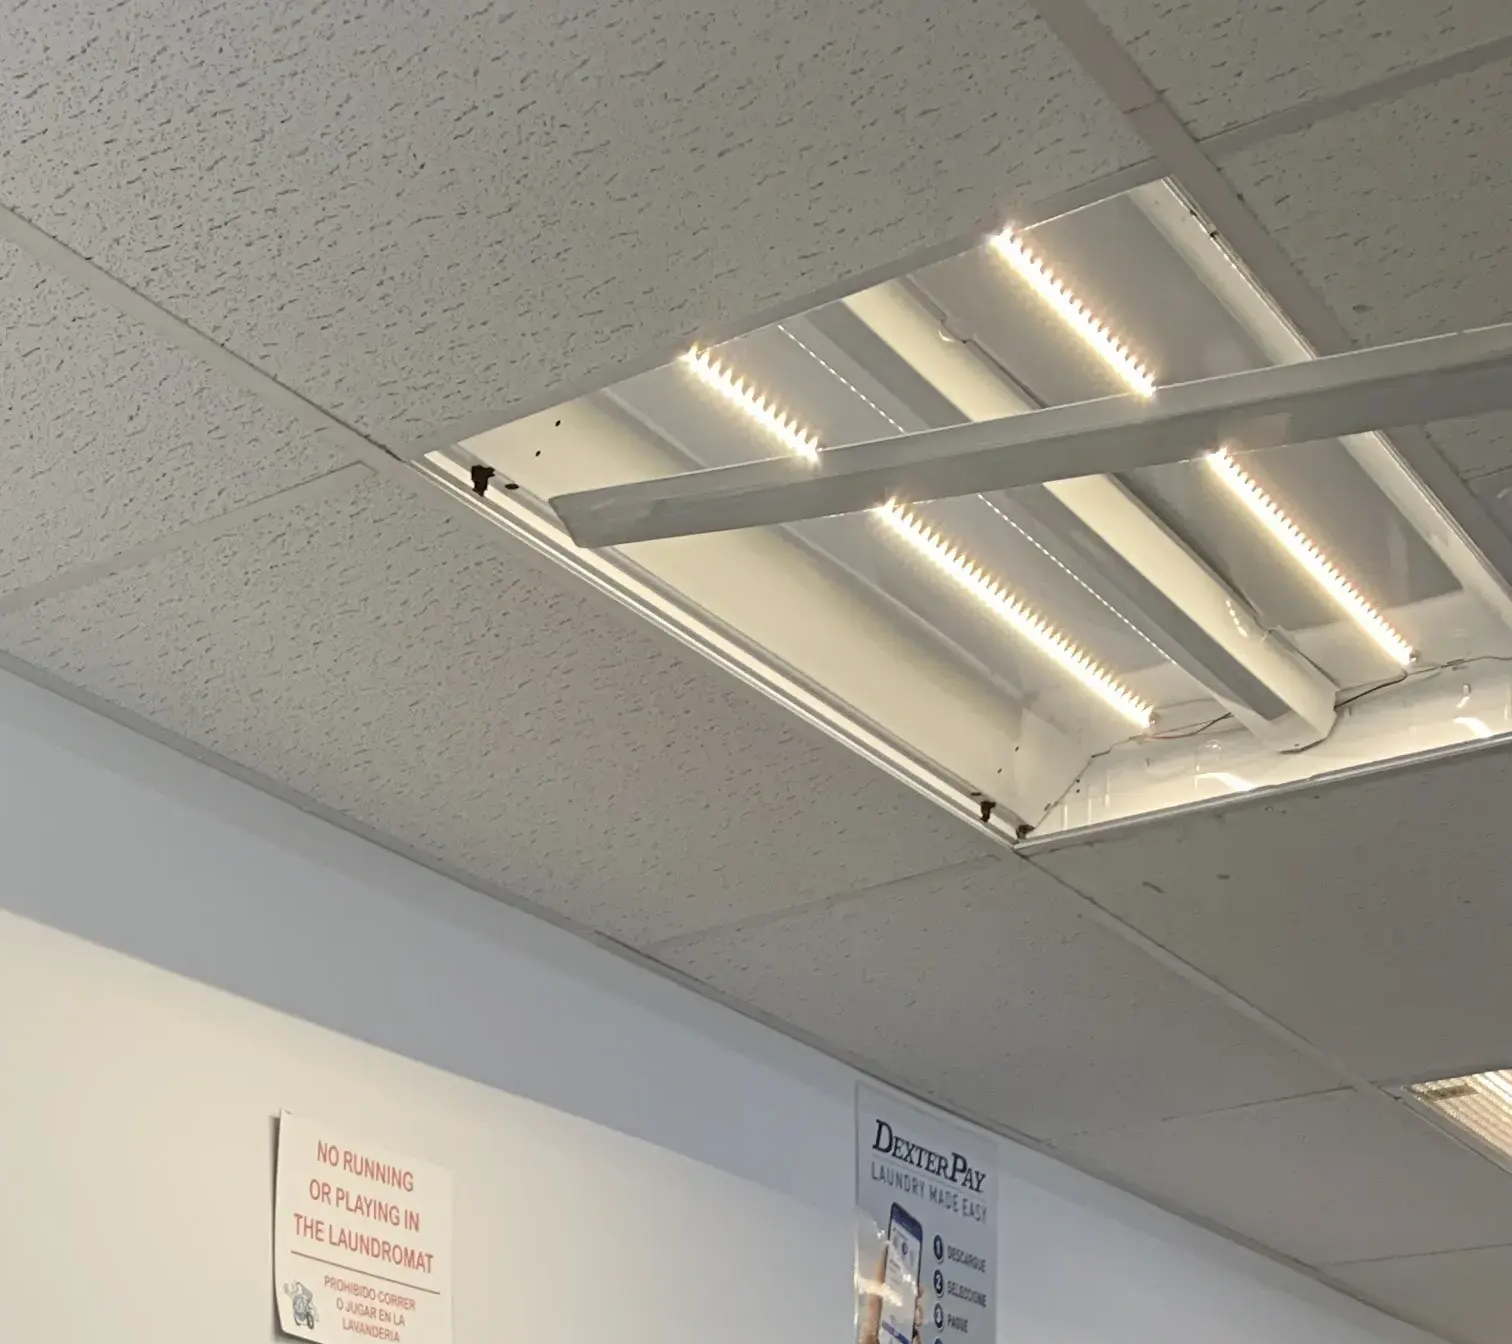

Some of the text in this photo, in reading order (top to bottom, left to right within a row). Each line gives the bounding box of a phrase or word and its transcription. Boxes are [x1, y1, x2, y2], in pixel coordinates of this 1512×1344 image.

[317, 1140, 415, 1193] NO RUNNING
[871, 1161, 988, 1224] LAUNDRY MADE EASY
[309, 1178, 420, 1233] OR PLAYING IN
[293, 1212, 435, 1274] THE LAUNDROMAT
[323, 1274, 416, 1311] PROHIBIDO CORRER
[336, 1297, 406, 1327] O JUGAR EN LA
[342, 1317, 401, 1343] LAVANDERIA
